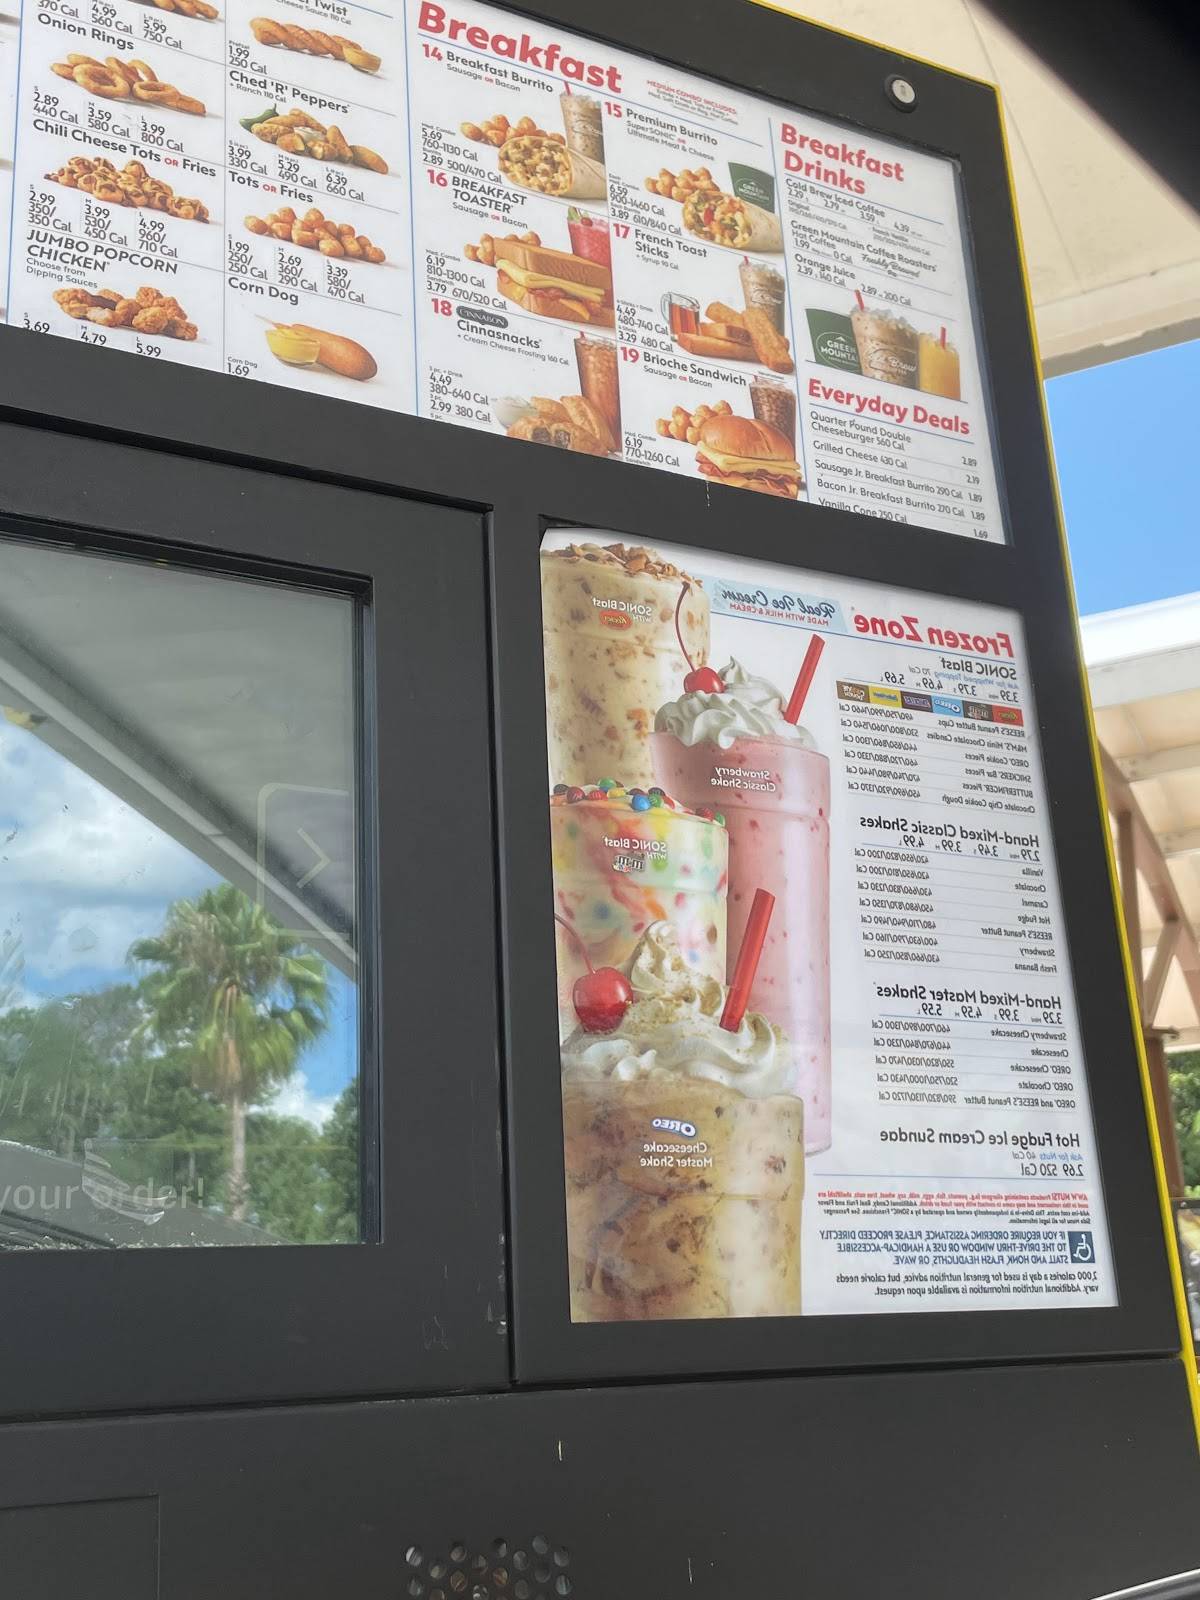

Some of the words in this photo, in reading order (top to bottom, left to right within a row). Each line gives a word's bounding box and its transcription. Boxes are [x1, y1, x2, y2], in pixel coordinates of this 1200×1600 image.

[314, 0, 347, 16] Twist
[38, 14, 86, 36] Onion
[92, 29, 134, 50] Rings
[144, 21, 166, 33] 5.99
[144, 30, 163, 42] 750
[165, 36, 183, 49] Cal
[418, 1, 621, 93] Breakfast
[422, 44, 442, 61] 14
[447, 51, 508, 77] Breakfast
[512, 72, 553, 92] Burrito
[447, 64, 482, 81] Sausage
[496, 78, 520, 92] Bacon
[34, 92, 59, 106] 2.89
[230, 70, 266, 89] Ched
[292, 88, 348, 113] Peppers
[34, 105, 57, 117] 440
[60, 110, 79, 124] Cal
[604, 102, 622, 118] 15
[627, 108, 677, 132] Premium
[680, 126, 717, 145] Burrito
[34, 119, 67, 138] Chili
[72, 130, 127, 153] Cheese
[130, 144, 160, 162] Tots
[183, 159, 216, 177] Fries
[781, 123, 904, 181] Breakfast
[423, 153, 443, 166] 2.89
[488, 170, 502, 184] Cal
[784, 150, 865, 194] Drinks
[29, 191, 55, 205] 2.99
[229, 170, 259, 188] Tots
[280, 185, 313, 202] Fries
[427, 169, 448, 187] 16
[452, 177, 527, 205] BREAKFAST
[786, 178, 806, 192] Cold
[810, 186, 832, 200] Brew
[834, 195, 853, 207] Iced
[856, 202, 885, 218] Coffee
[452, 202, 488, 218] Sausage
[502, 216, 528, 228] Bacon
[453, 189, 511, 213] TOASTER
[140, 219, 164, 232] 4.99
[27, 230, 89, 253] JUMBO
[94, 244, 178, 274] POPCORN
[613, 223, 630, 239] 17
[635, 229, 673, 248] French
[676, 240, 707, 257] Toast
[635, 242, 669, 259] Sticks
[791, 220, 819, 233] Green
[821, 228, 864, 250] Mountain
[866, 245, 896, 260] Coffee
[27, 258, 61, 271] Choose
[65, 266, 85, 276] from
[28, 245, 107, 272] CHICKEN
[327, 265, 348, 277] 3.39
[426, 255, 445, 266] 6.19
[795, 253, 831, 271] Orange
[833, 265, 856, 279] Juice
[27, 266, 63, 282] Dipping
[66, 274, 98, 288] Sauces
[228, 277, 264, 294] Corn
[269, 286, 299, 305] Dog
[427, 281, 446, 293] 3.79
[452, 288, 490, 306] 670/520
[492, 298, 507, 310] Cal
[432, 298, 452, 316] 18
[459, 307, 505, 326] CINNABON
[457, 320, 539, 348] Cinnasnacks
[619, 331, 637, 343] 3.29
[641, 336, 657, 348] 480
[660, 341, 673, 352] Cal
[137, 343, 160, 357] 5.99
[228, 363, 249, 376] 1.69
[430, 372, 452, 385] 4.49
[621, 347, 639, 363] 19
[644, 352, 687, 371] Brioche
[690, 364, 746, 386] Sandwich
[644, 365, 677, 380] Sausage
[689, 376, 712, 388] Bacon
[808, 379, 908, 423] Everyday
[913, 406, 969, 434] Deals
[811, 411, 846, 427] Quarter
[849, 419, 877, 435] Pound
[880, 428, 911, 442] Double
[812, 422, 874, 444] Cheeseburger
[893, 440, 904, 450] Cal
[814, 440, 843, 455] Grilled
[846, 448, 878, 462] Cheese
[895, 458, 907, 469] Cal
[815, 460, 852, 476] Sausage
[854, 468, 863, 478] Jr.
[866, 471, 905, 487] Breakfast
[907, 481, 934, 493] Burrito
[818, 479, 846, 493] Bacon
[849, 485, 858, 495] Jr.
[861, 488, 903, 504] Breakfast
[906, 498, 935, 511] Burrito
[91, 1177, 203, 1209] order!
